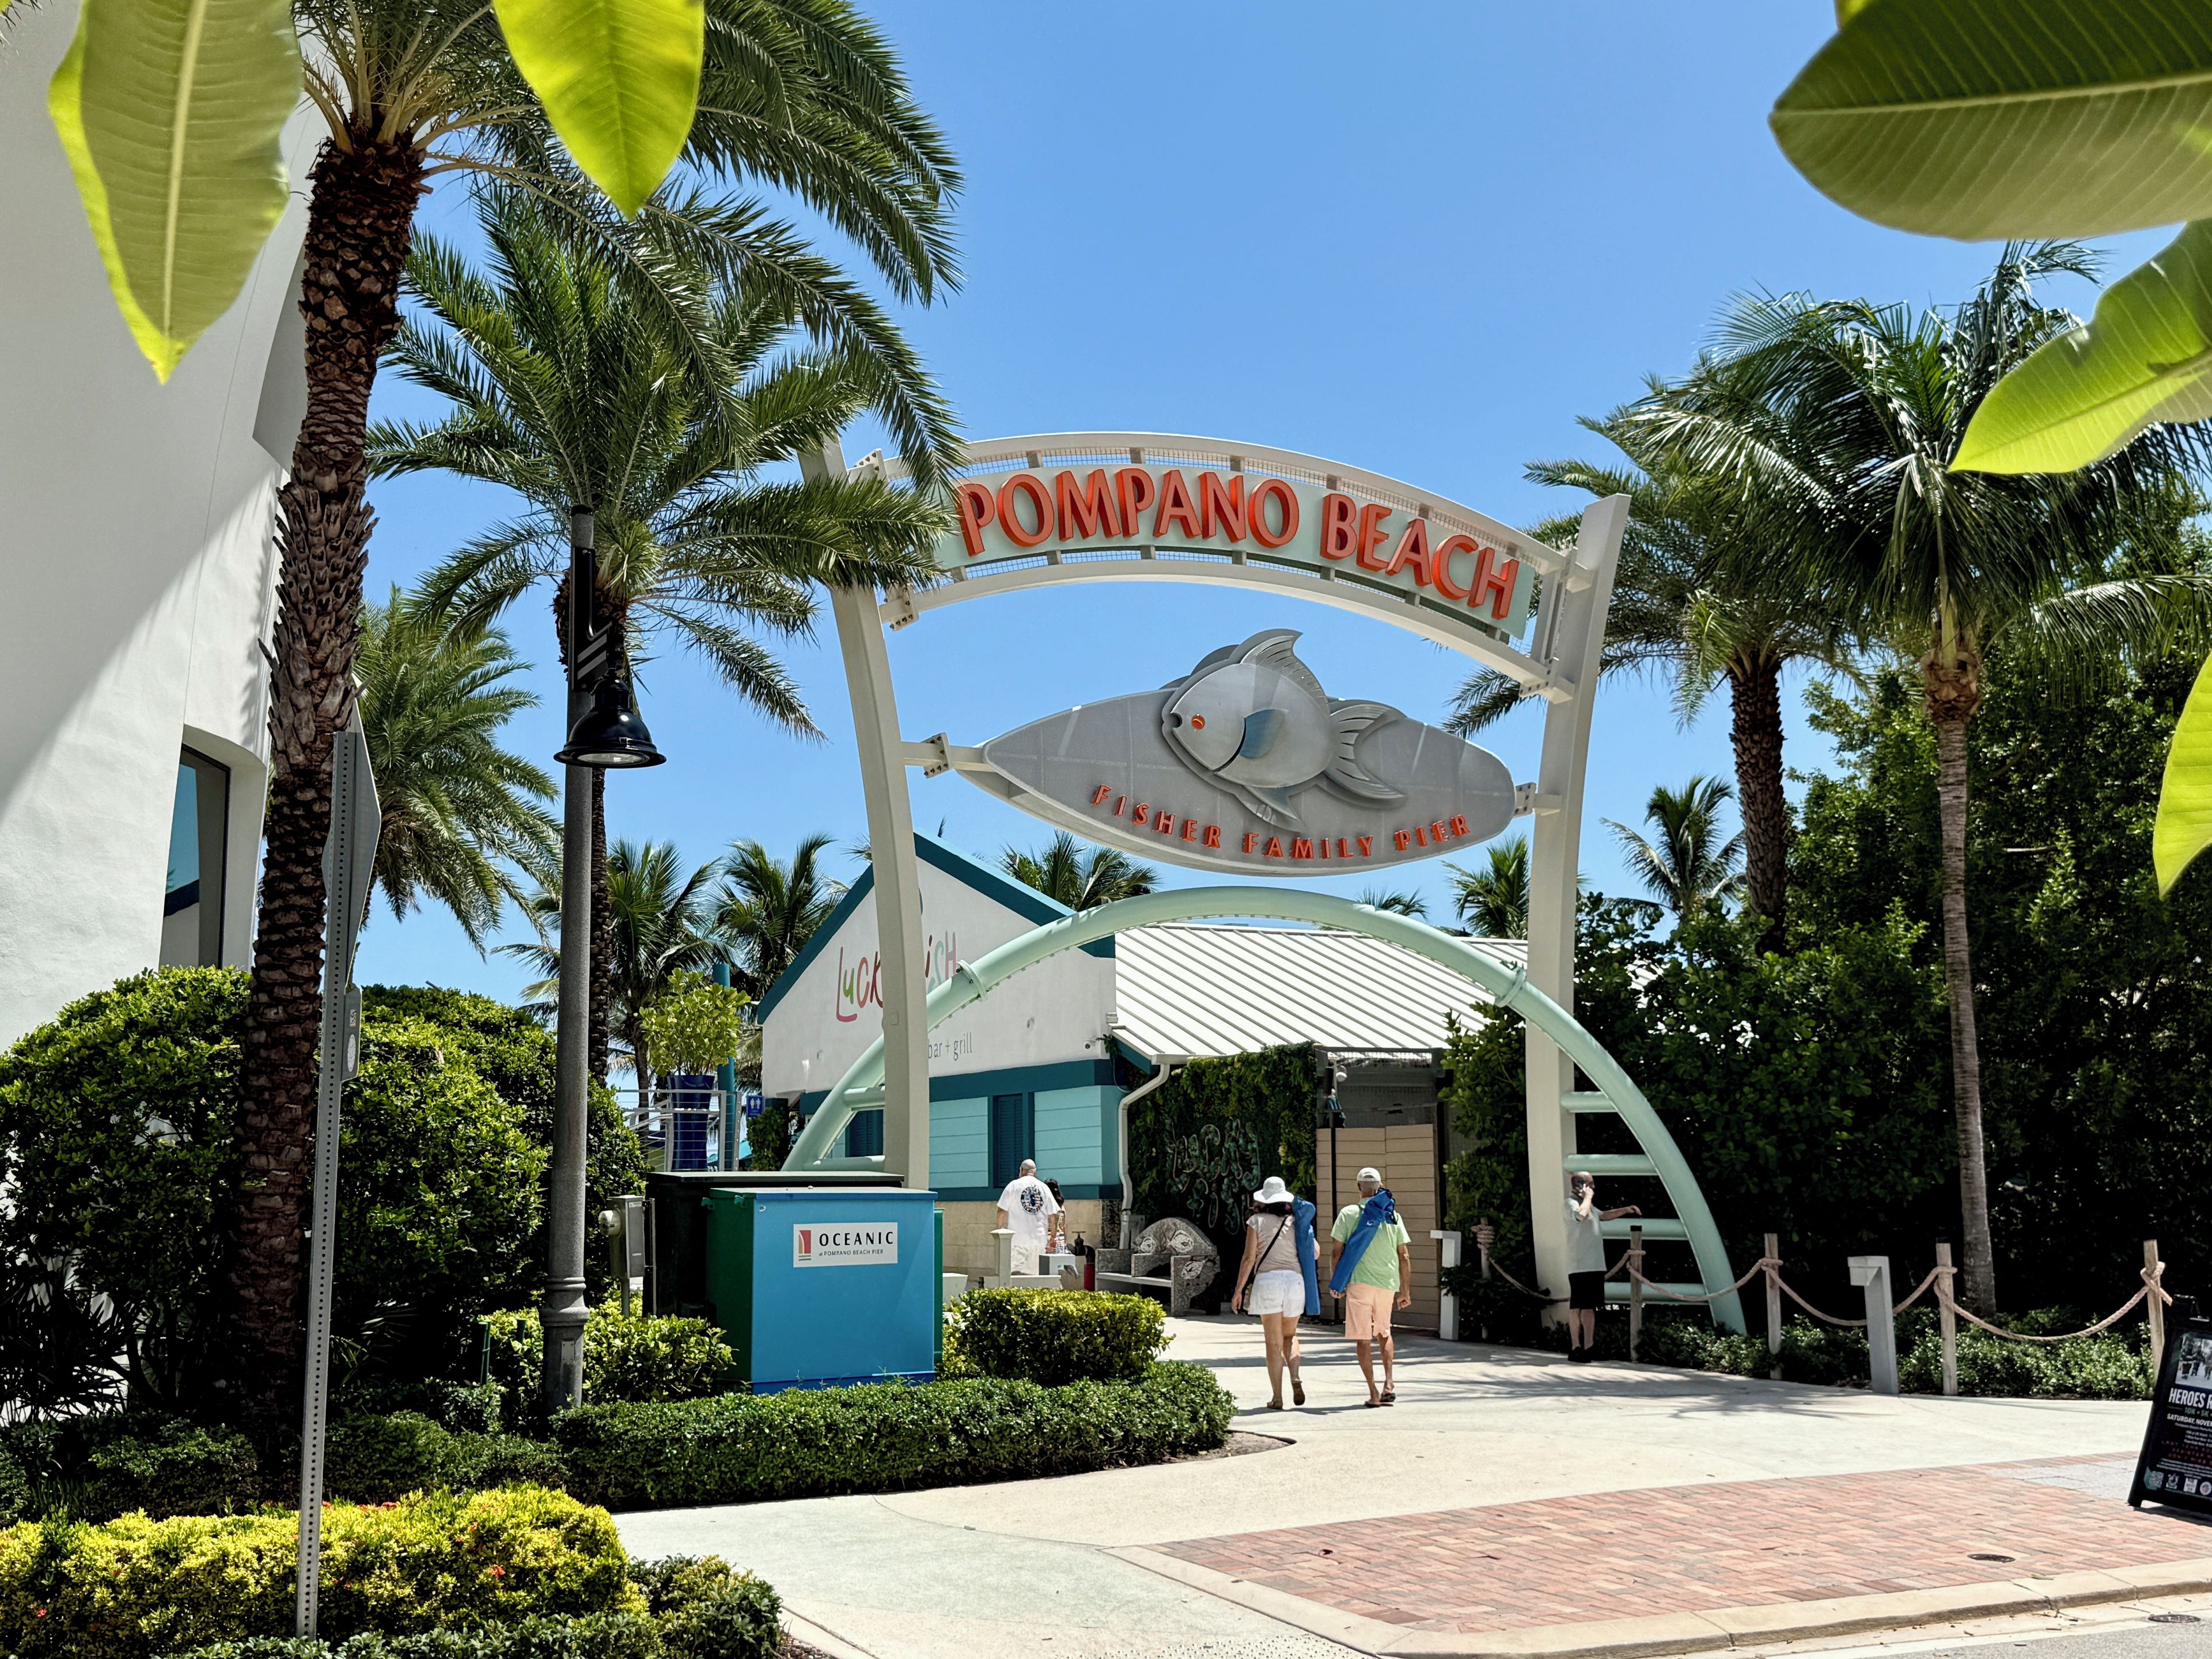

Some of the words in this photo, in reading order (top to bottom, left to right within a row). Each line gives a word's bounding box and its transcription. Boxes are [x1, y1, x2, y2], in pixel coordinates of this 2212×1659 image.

[956, 468, 1300, 557] POMPANO
[1319, 491, 1520, 620] BEACH
[1092, 784, 1222, 849] FISHER
[1243, 832, 1374, 860] FAMILY
[1394, 813, 1470, 852] PIER
[953, 1032, 973, 1061] grill
[819, 1231, 893, 1247] OCEANIC
[2168, 1387, 2206, 1408] HEROES
[2166, 1413, 2195, 1424] SATURDAY,
